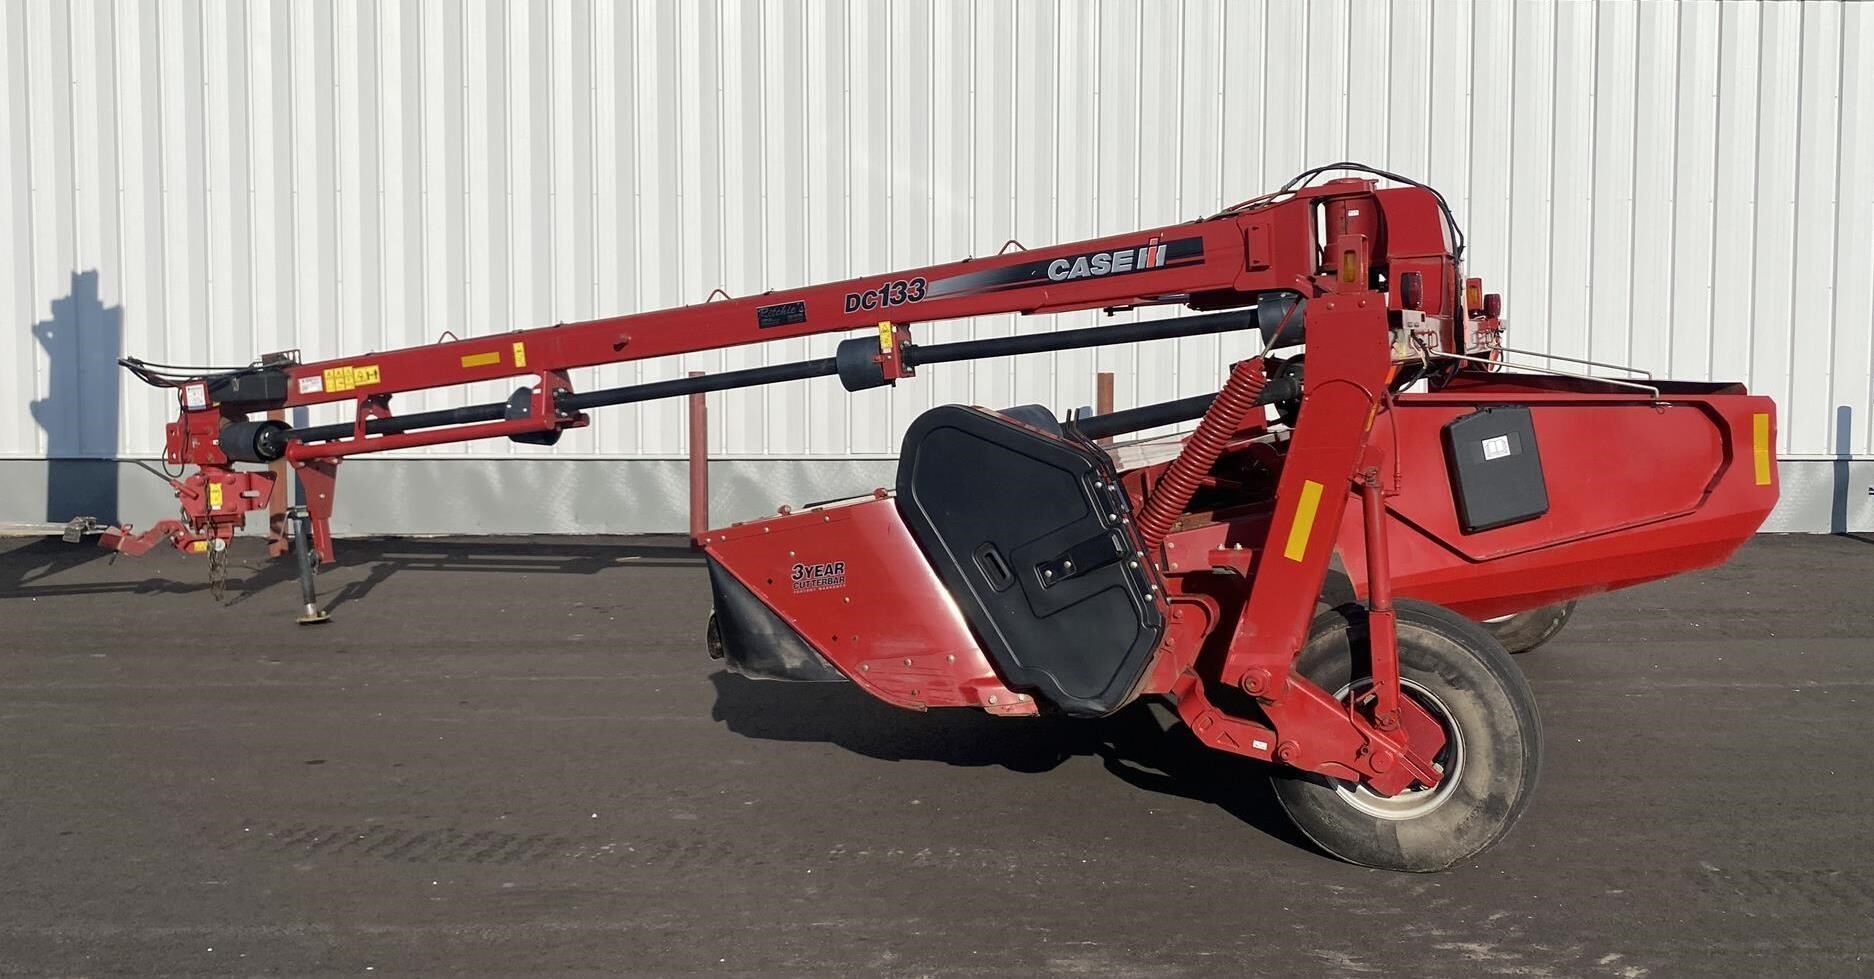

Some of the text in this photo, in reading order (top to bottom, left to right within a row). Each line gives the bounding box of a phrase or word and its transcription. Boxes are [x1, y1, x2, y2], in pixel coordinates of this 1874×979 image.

[1047, 249, 1134, 281] CASE
[844, 276, 926, 314] DC133
[793, 576, 845, 589] CUTTERBAR
